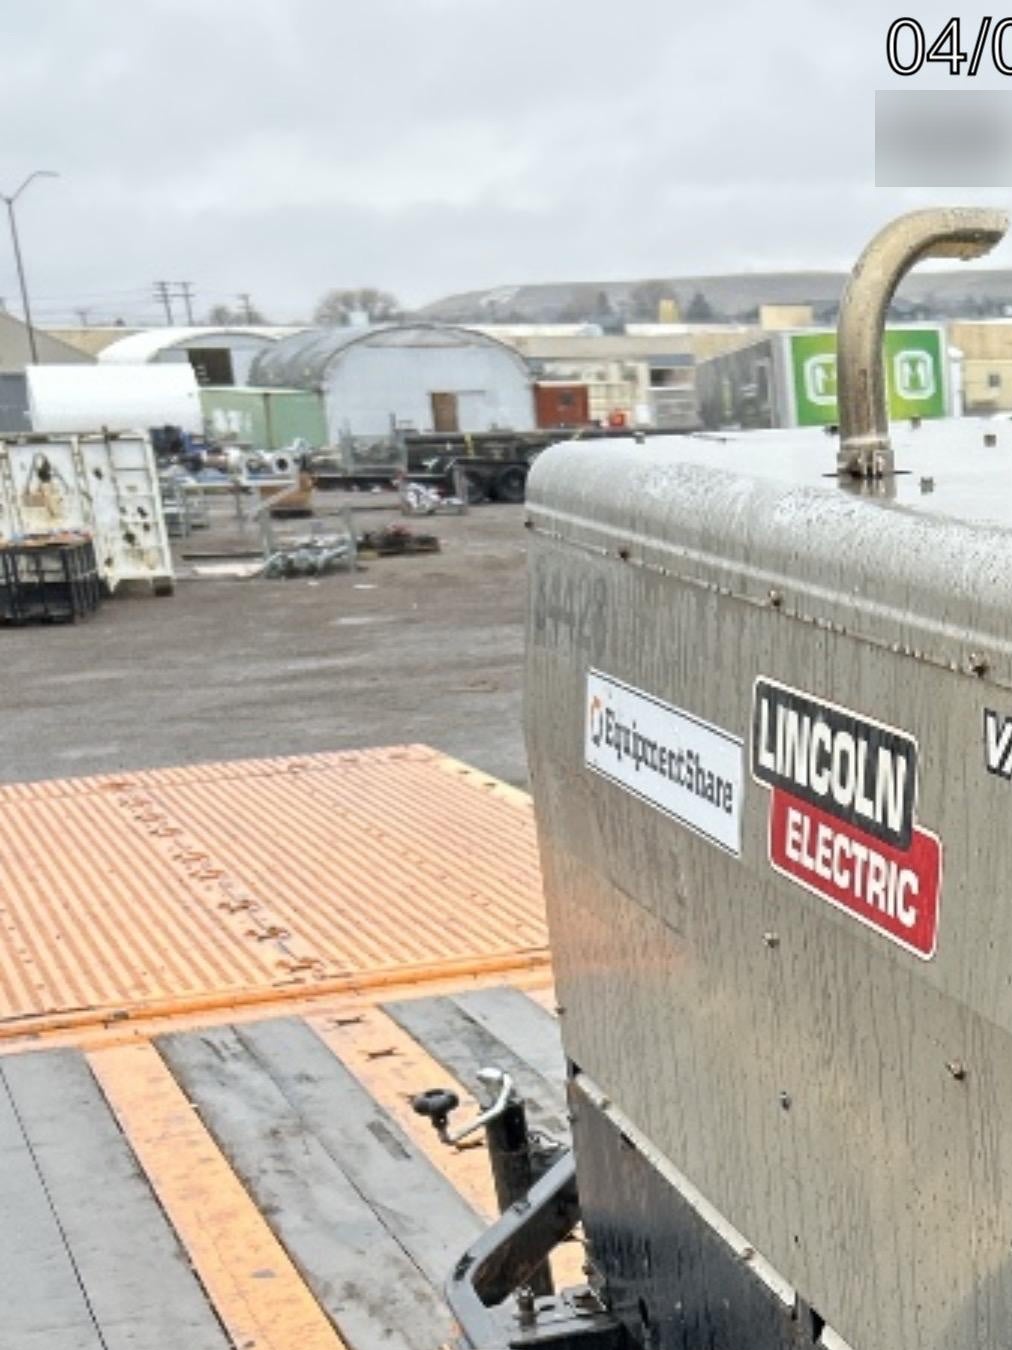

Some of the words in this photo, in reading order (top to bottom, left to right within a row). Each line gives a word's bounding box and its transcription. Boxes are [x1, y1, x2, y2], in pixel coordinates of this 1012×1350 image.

[605, 706, 733, 815] EquipmentShare
[759, 697, 908, 833] LINCOLN
[785, 808, 920, 930] ELECTRIC
